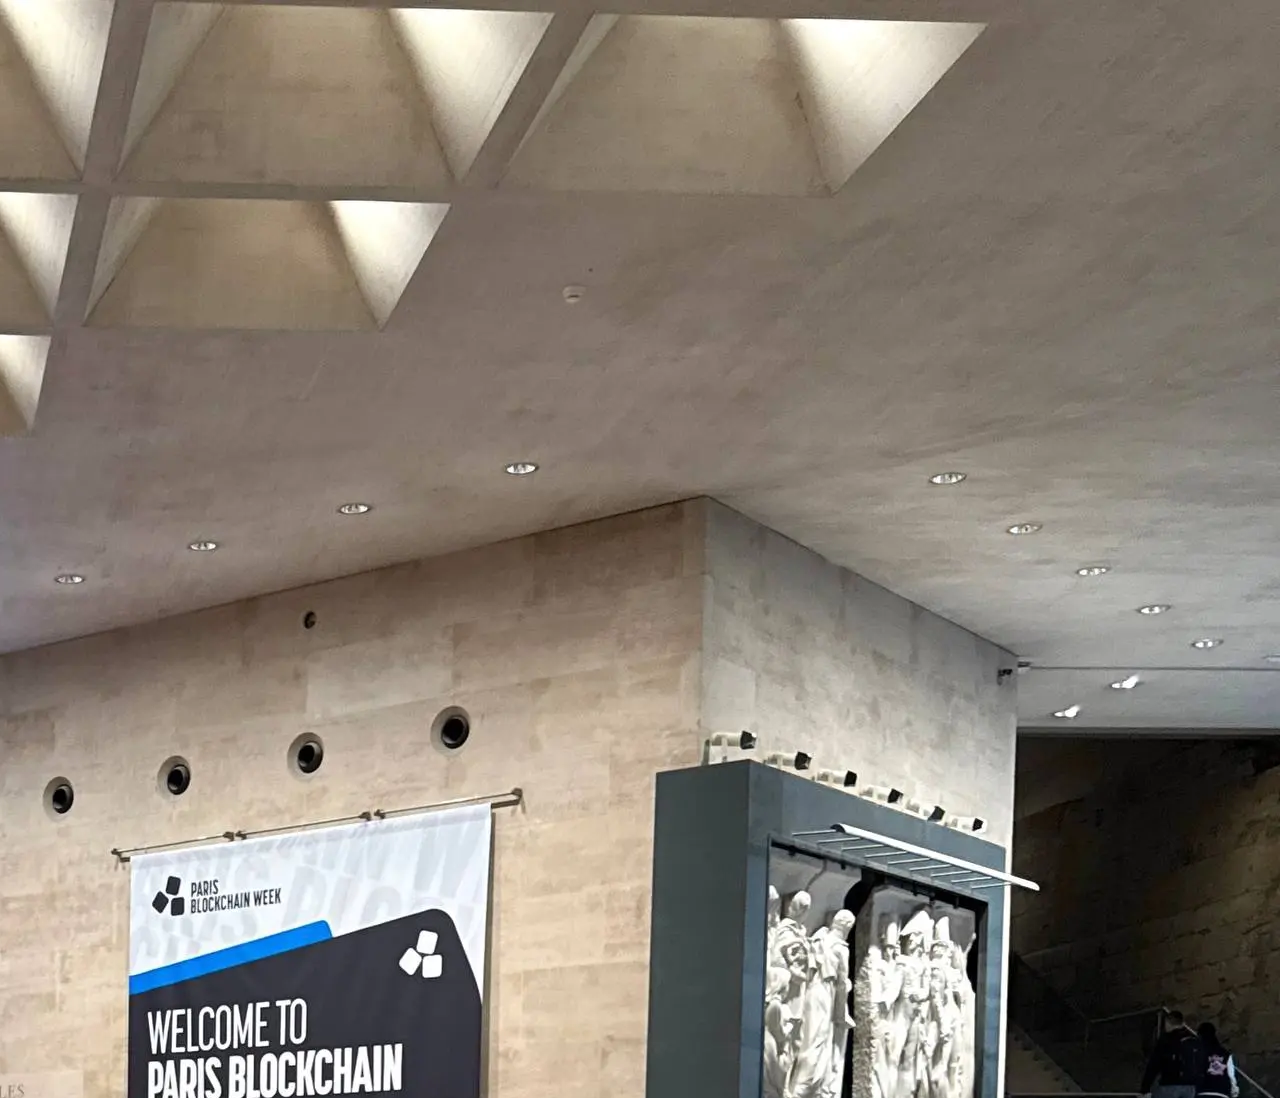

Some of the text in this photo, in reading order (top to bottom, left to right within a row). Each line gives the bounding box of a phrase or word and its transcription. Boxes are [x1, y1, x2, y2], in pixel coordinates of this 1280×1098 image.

[191, 879, 219, 897] PARIS
[191, 887, 281, 914] BLOCKCHAIN WEEK
[147, 998, 308, 1055] WELCOME TO
